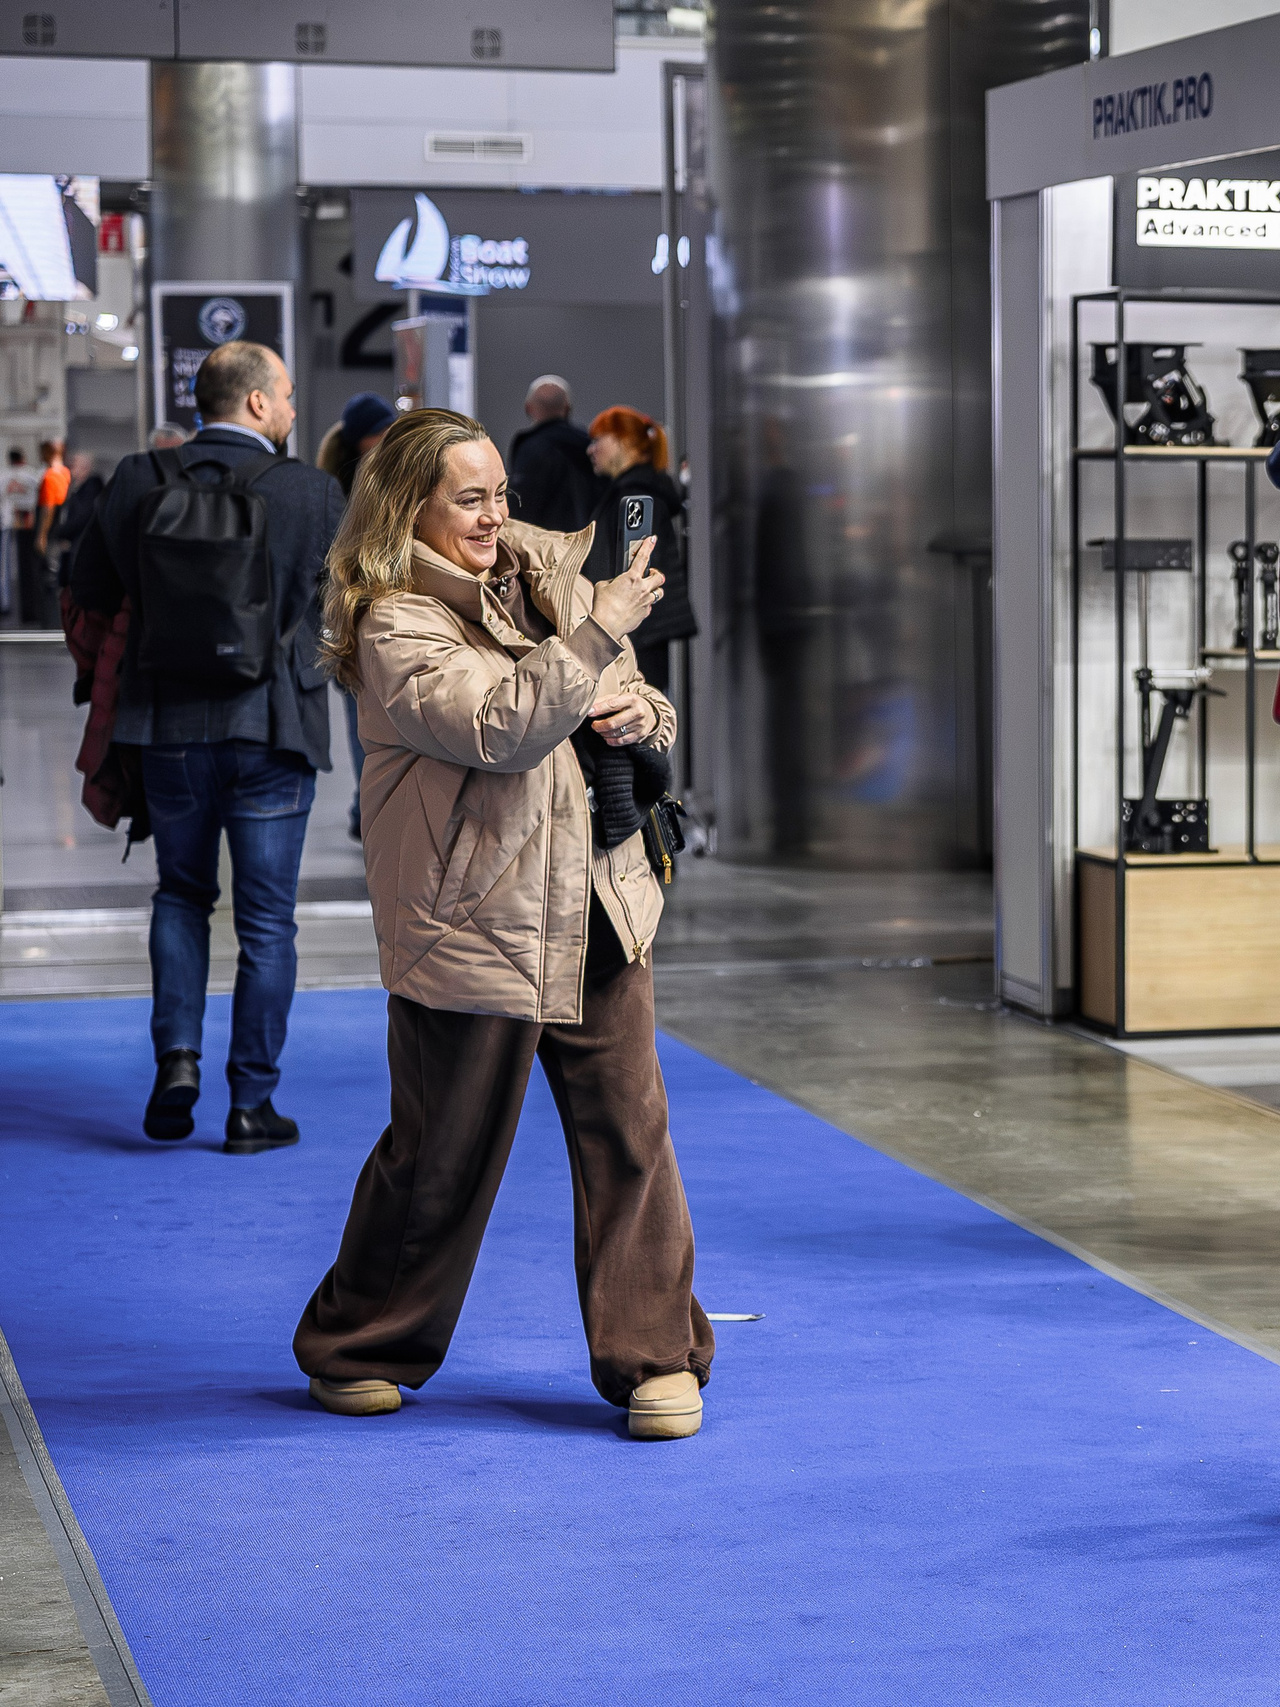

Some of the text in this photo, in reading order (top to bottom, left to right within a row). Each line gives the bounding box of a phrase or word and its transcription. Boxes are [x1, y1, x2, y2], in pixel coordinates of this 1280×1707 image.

[1093, 72, 1214, 140] PRAKTIK.PRO
[1144, 218, 1267, 239] Advanced
[459, 234, 530, 266] Boat
